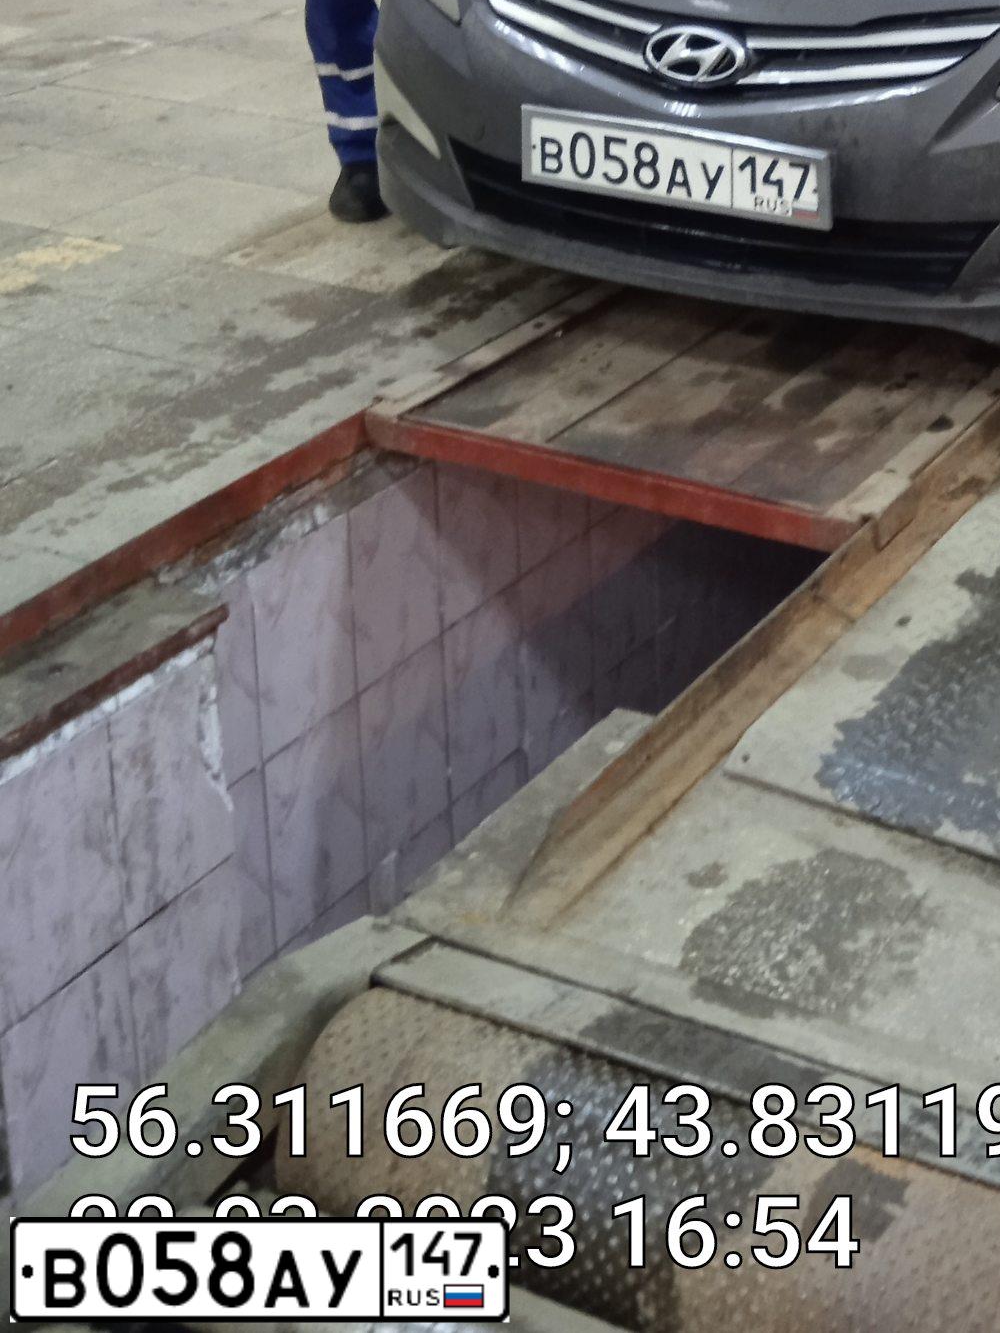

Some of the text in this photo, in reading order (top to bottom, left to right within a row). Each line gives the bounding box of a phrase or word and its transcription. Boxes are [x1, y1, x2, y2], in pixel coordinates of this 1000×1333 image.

[540, 131, 811, 201] В058АУ 147
[753, 195, 790, 216] RUS
